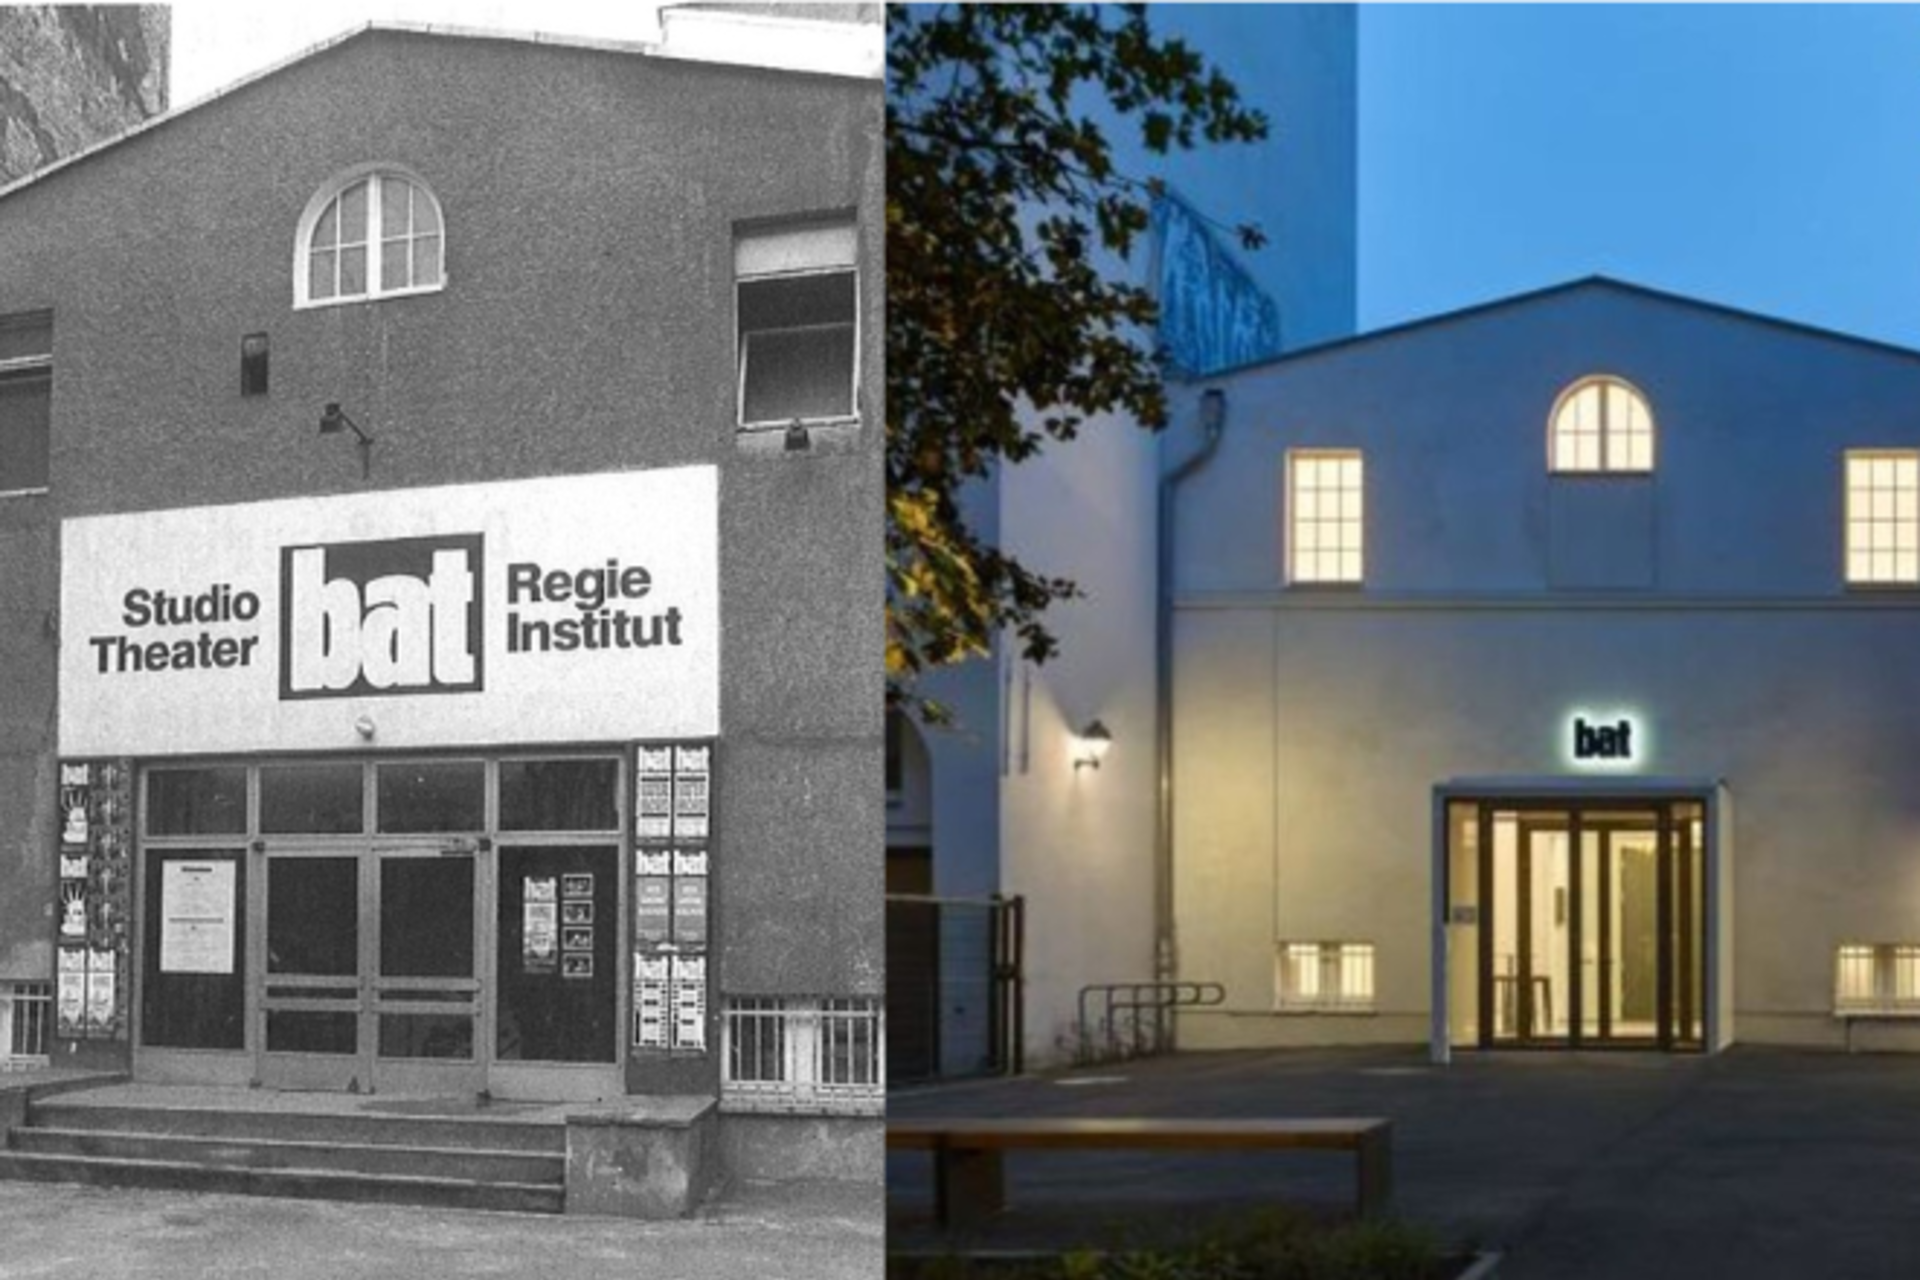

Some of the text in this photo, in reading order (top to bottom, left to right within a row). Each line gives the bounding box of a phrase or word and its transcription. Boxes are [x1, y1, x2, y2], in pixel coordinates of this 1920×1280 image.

[121, 583, 262, 629] Studio
[506, 559, 651, 611] Regie
[290, 547, 475, 691] bat
[506, 607, 682, 653] Institut
[89, 633, 261, 674] Theater
[1575, 718, 1631, 758] bat
